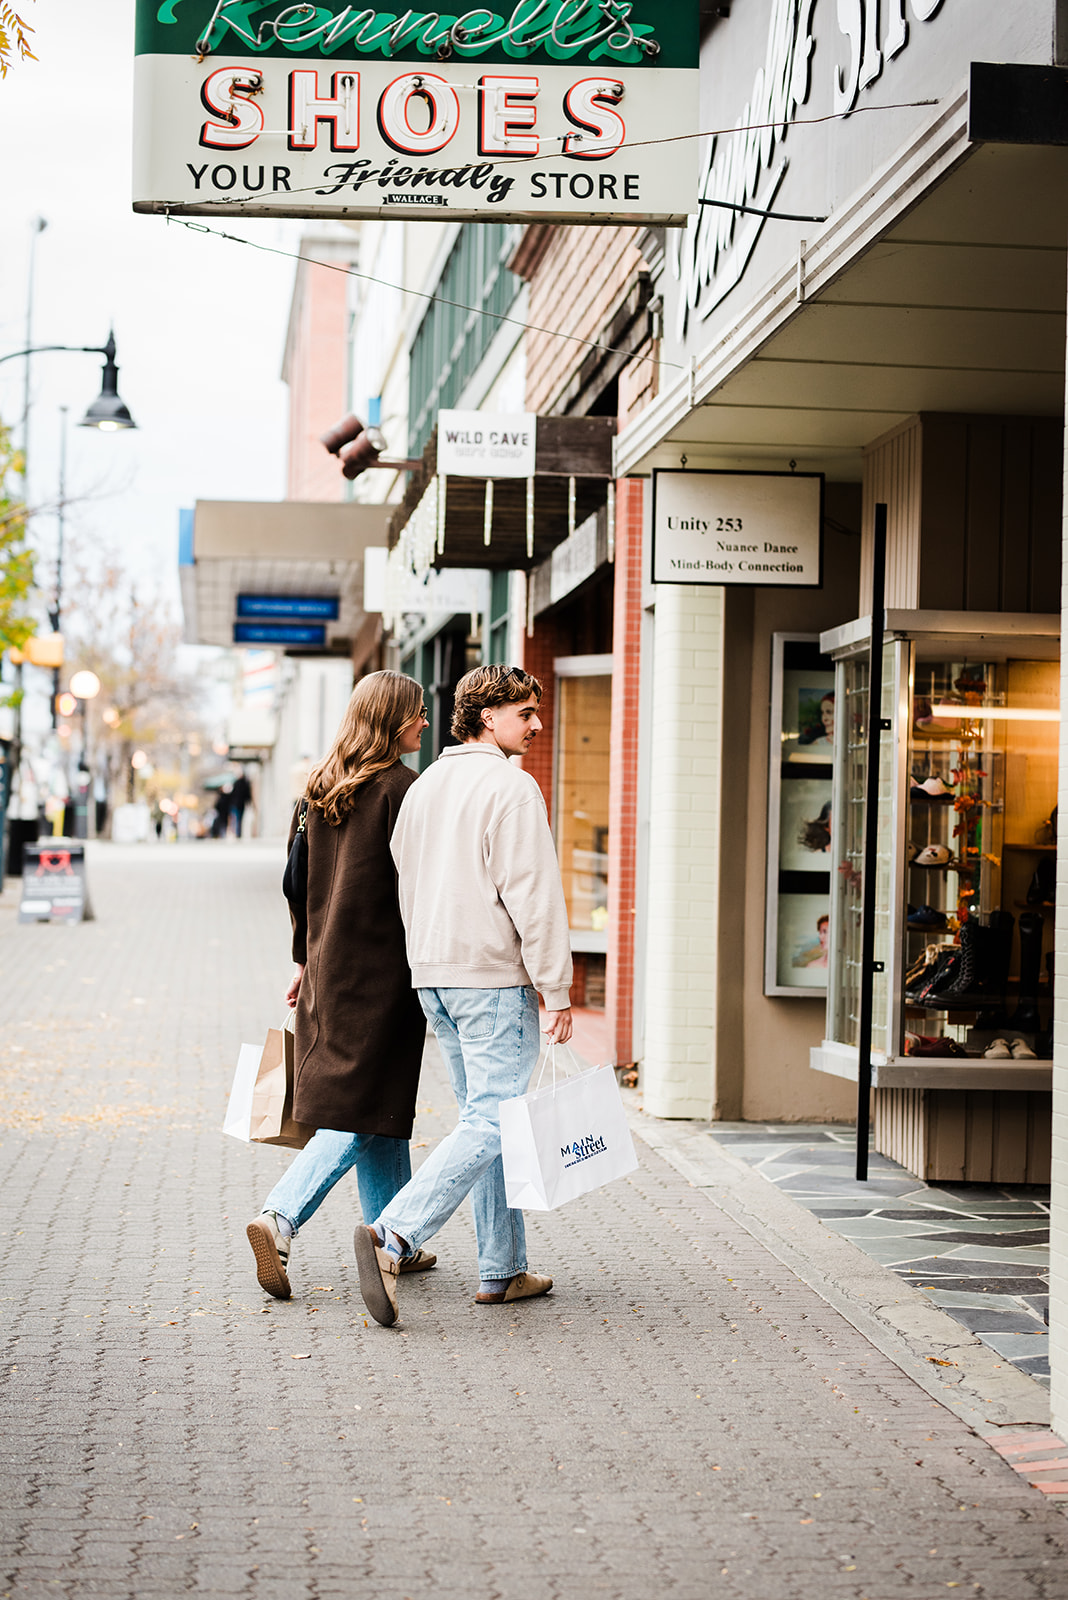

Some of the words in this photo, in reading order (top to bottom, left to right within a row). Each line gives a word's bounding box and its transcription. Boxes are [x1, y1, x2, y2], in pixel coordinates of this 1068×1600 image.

[199, 67, 626, 161] SHOES
[186, 163, 292, 191] YOUR
[315, 158, 515, 203] Friendly
[530, 172, 640, 200] STORE
[391, 195, 439, 204] WALLACE
[489, 431, 529, 446] CAVE
[667, 516, 710, 535] Unity
[716, 518, 743, 532] 253
[716, 541, 759, 552] Nuance
[763, 542, 799, 554] Dance
[670, 559, 735, 573] Mind-Body
[738, 560, 804, 573] Connection
[560, 1134, 594, 1158] MAIN
